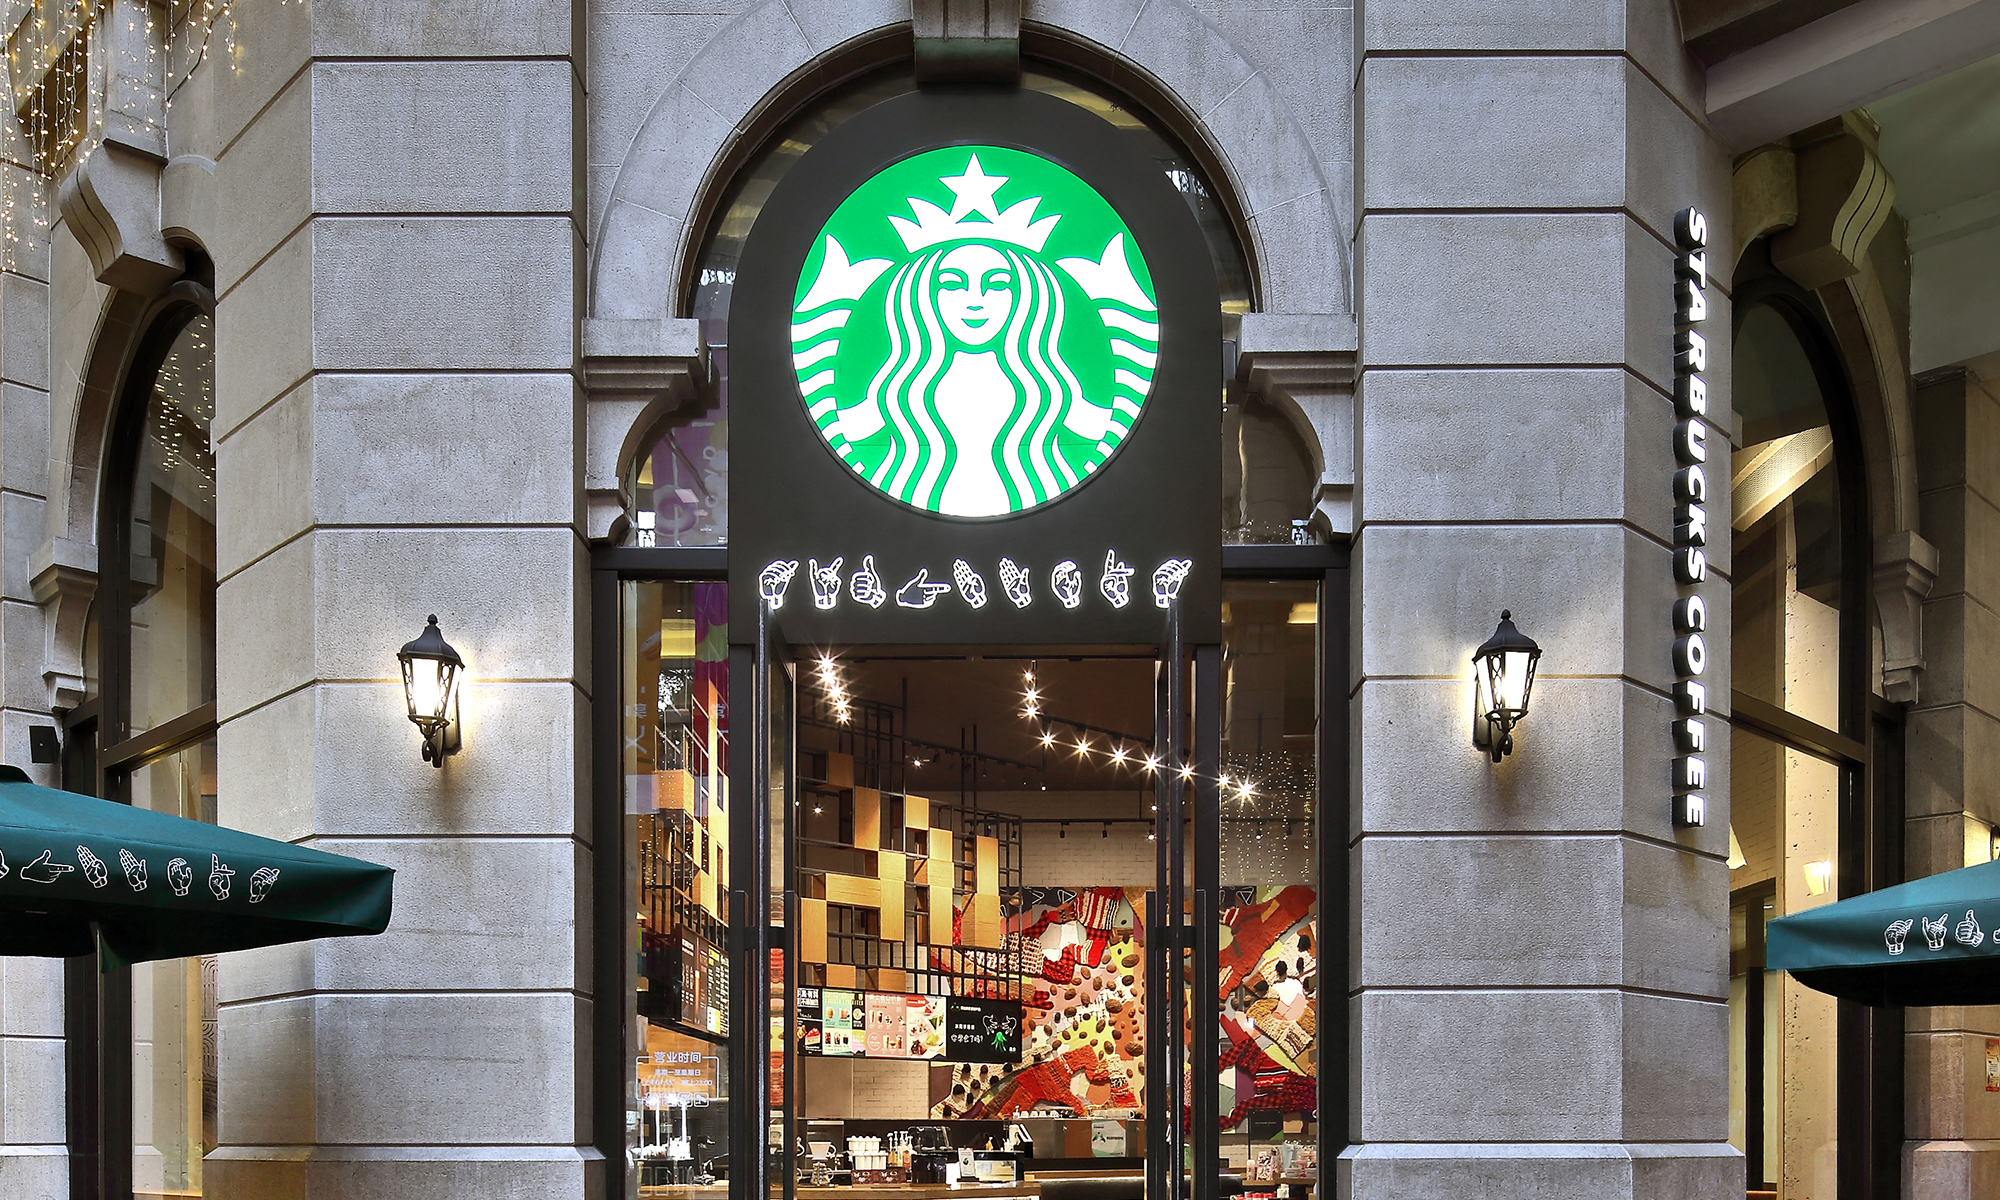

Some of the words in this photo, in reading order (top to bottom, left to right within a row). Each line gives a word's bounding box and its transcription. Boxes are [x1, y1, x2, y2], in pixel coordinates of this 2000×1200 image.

[1683, 205, 1708, 583] STARBUCKS
[1681, 594, 1708, 828] COFFEE
[653, 1051, 702, 1064] 营业时间
